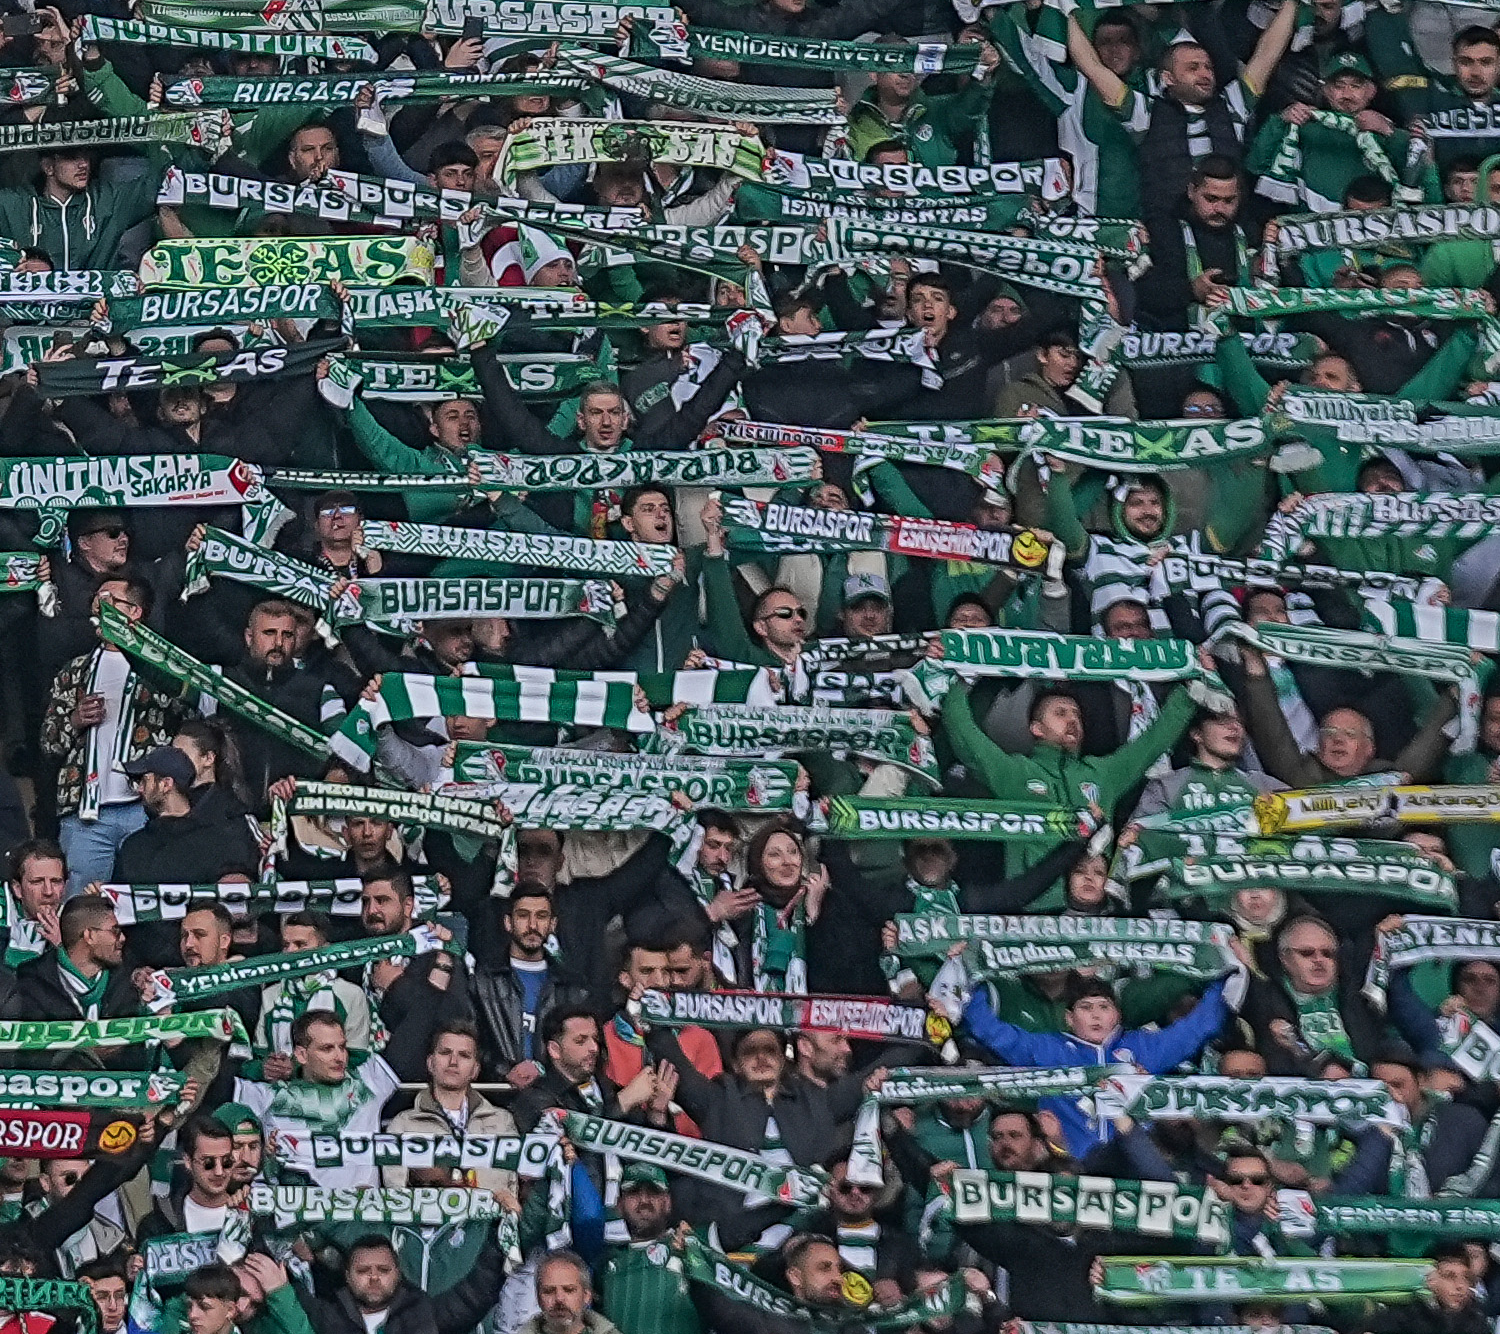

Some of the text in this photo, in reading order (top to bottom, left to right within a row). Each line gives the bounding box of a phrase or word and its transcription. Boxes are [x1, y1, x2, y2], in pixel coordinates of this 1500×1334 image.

[695, 29, 799, 59] YENİDEN
[139, 285, 321, 320] BURSASPOR
[1064, 424, 1263, 457] TEXAS
[131, 471, 214, 499] SAKARYA
[766, 501, 874, 542] BURSASPOR
[420, 527, 616, 564] BURSASPOR
[382, 577, 568, 617] BURSASPOR
[857, 807, 1047, 835] BURSASPOR
[896, 916, 950, 946] AŞK
[956, 914, 1115, 941] FEDAKARLIK
[673, 990, 785, 1026] BURSASPOR
[589, 1117, 767, 1189] BURSASPOR
[252, 1183, 498, 1223] BURSASPOR
[960, 1171, 1230, 1232] BURSASPOR
